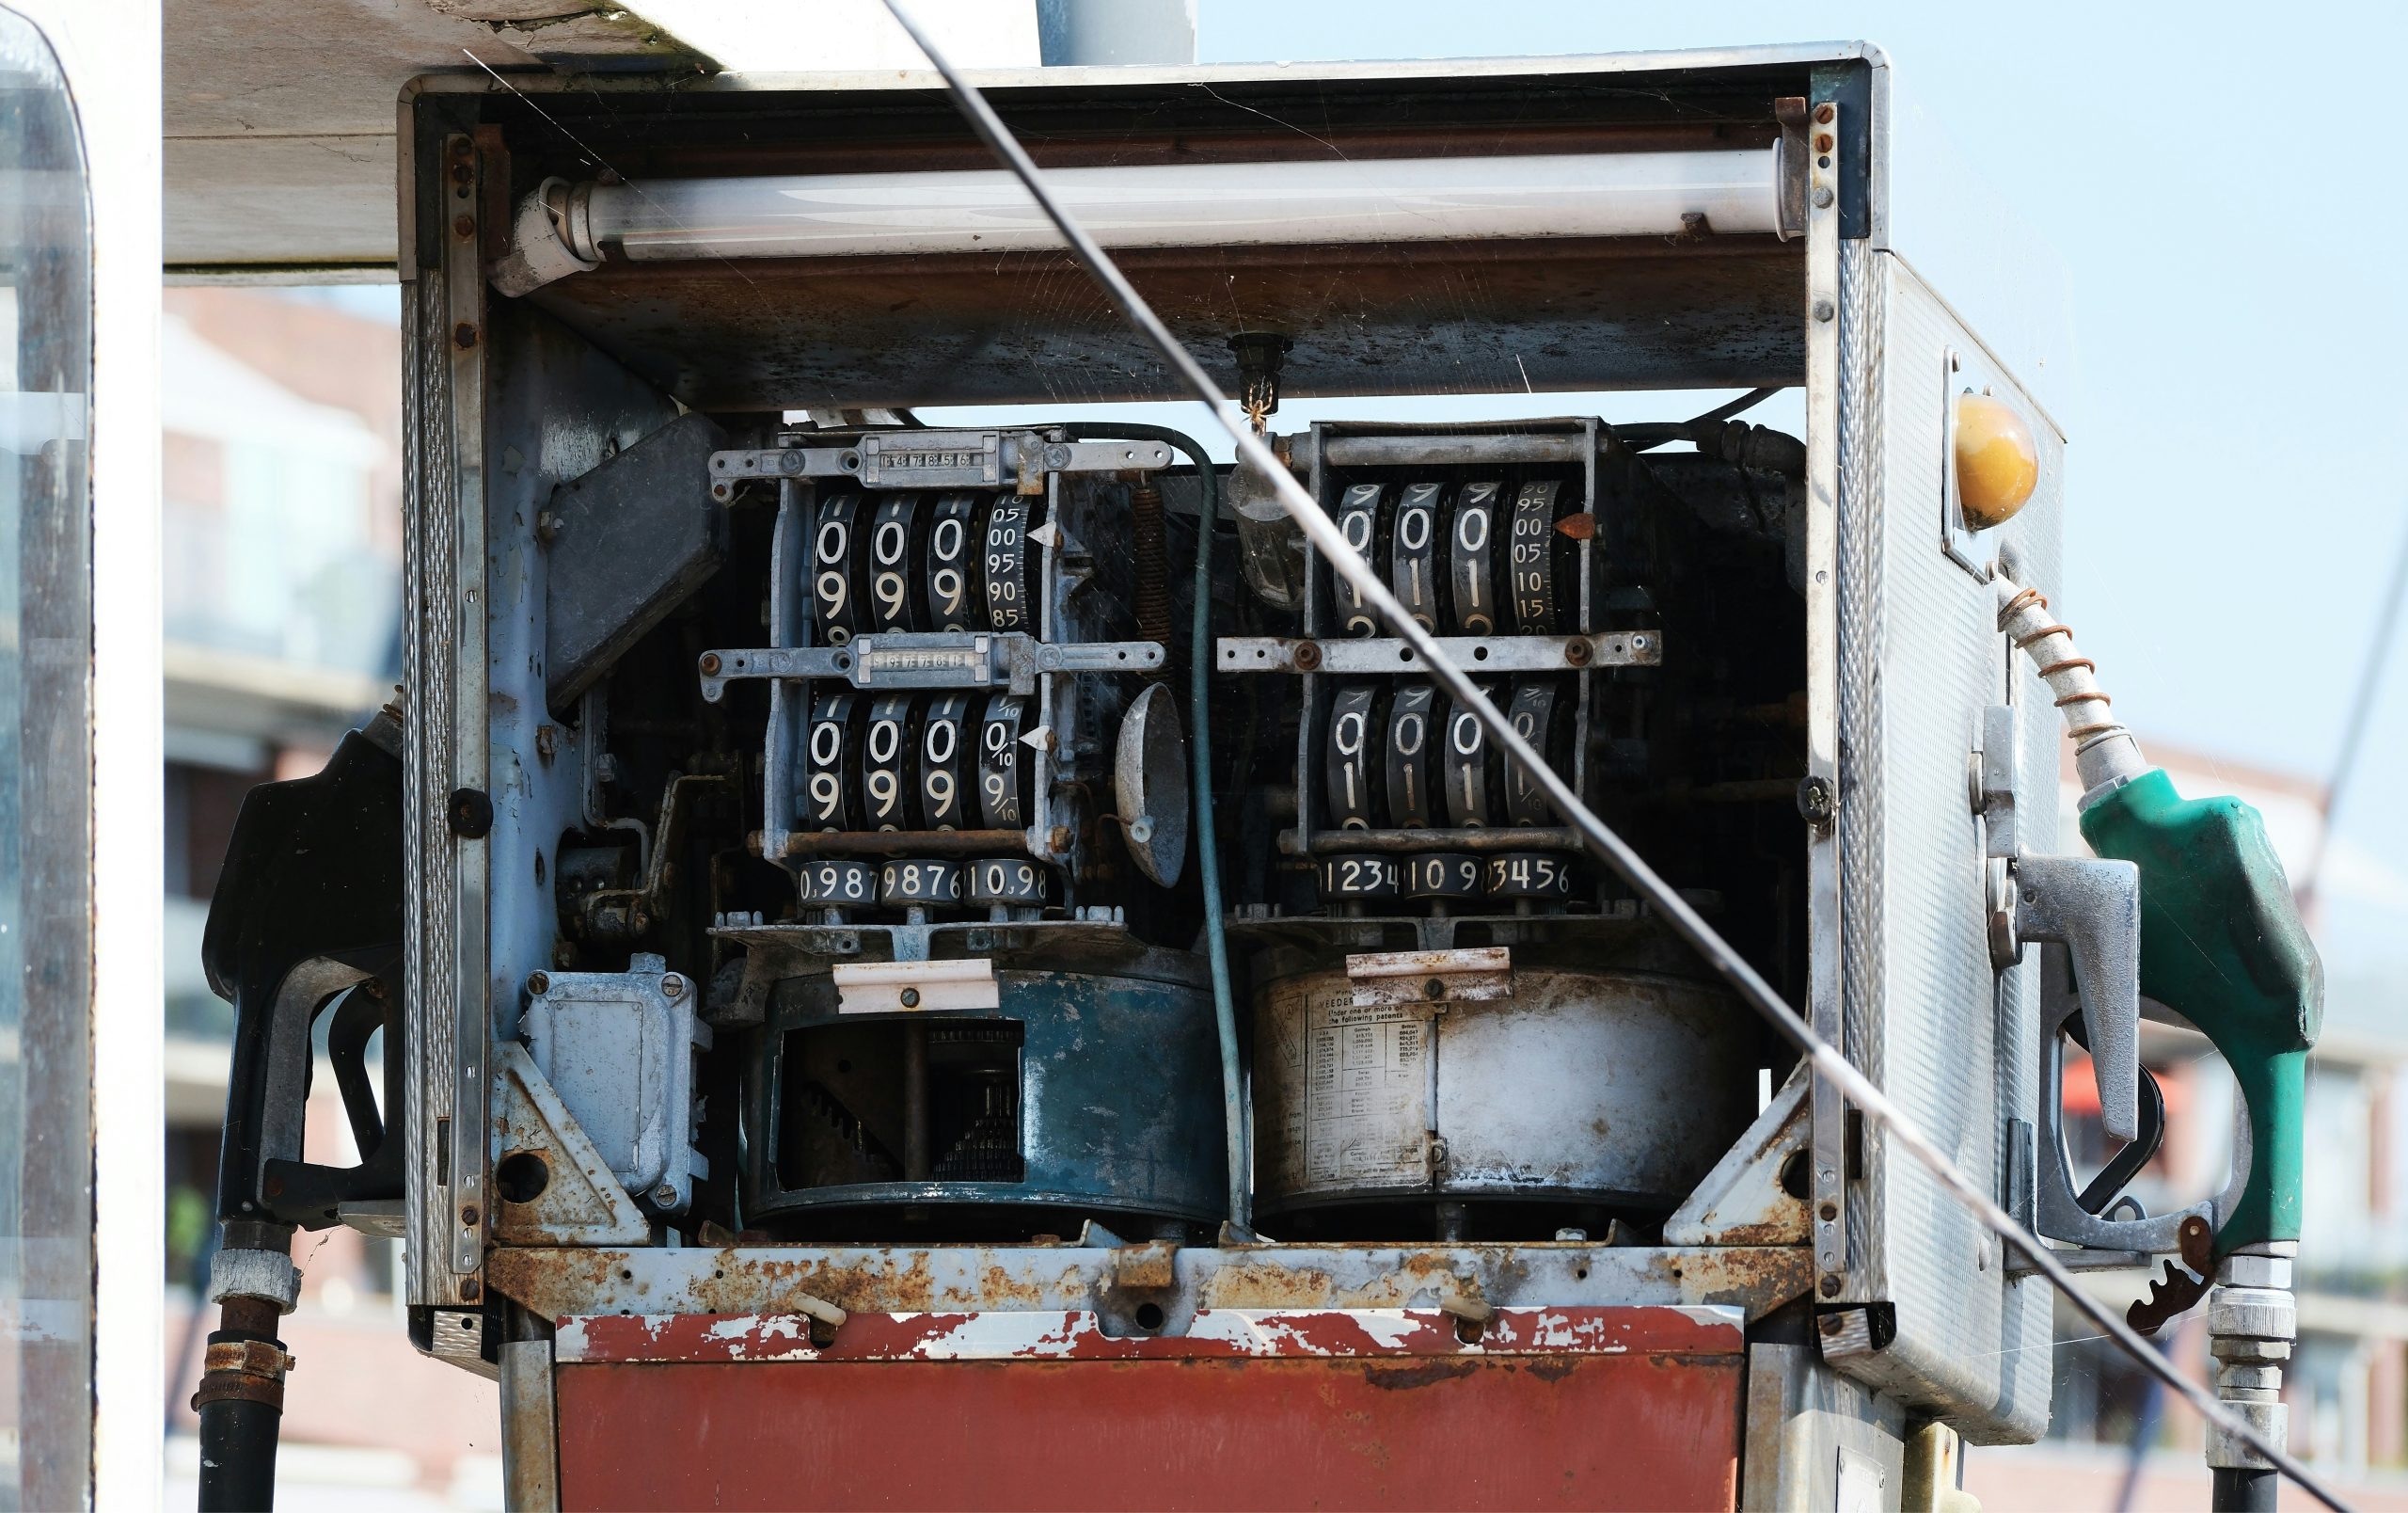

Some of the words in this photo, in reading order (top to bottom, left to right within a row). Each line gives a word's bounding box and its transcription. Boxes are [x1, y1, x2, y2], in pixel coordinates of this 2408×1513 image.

[992, 508, 1020, 523] 05
[1517, 498, 1545, 512] 95
[817, 521, 847, 565] 0
[875, 521, 905, 565] 0
[934, 518, 963, 562] 0
[989, 528, 1016, 547] 00
[1342, 510, 1370, 552] 0
[1401, 508, 1430, 550] 0
[1459, 508, 1488, 551] 0
[1515, 518, 1542, 536] 00
[988, 553, 1016, 574] 95
[1514, 543, 1542, 564] 05
[816, 570, 847, 620] 9
[875, 571, 905, 621] 9
[934, 568, 962, 616] 9
[989, 581, 1016, 601] 90
[1409, 557, 1420, 606] 1
[1467, 558, 1480, 608] 1
[1518, 571, 1543, 592] 10
[992, 609, 1019, 627] 85
[1519, 599, 1544, 617] 15
[811, 722, 841, 766] 0
[869, 720, 899, 764] 0
[927, 719, 956, 763] 0
[1394, 712, 1424, 756] 0
[1453, 711, 1482, 755] 0
[810, 772, 840, 820] 9
[868, 770, 897, 819] 9
[926, 770, 955, 819] 9
[1343, 761, 1356, 809] 1
[1402, 763, 1416, 810] 1
[1462, 762, 1474, 810] 1
[883, 864, 961, 900] 9876
[1341, 1014, 1372, 1024] following
[1376, 1012, 1403, 1022] patents
